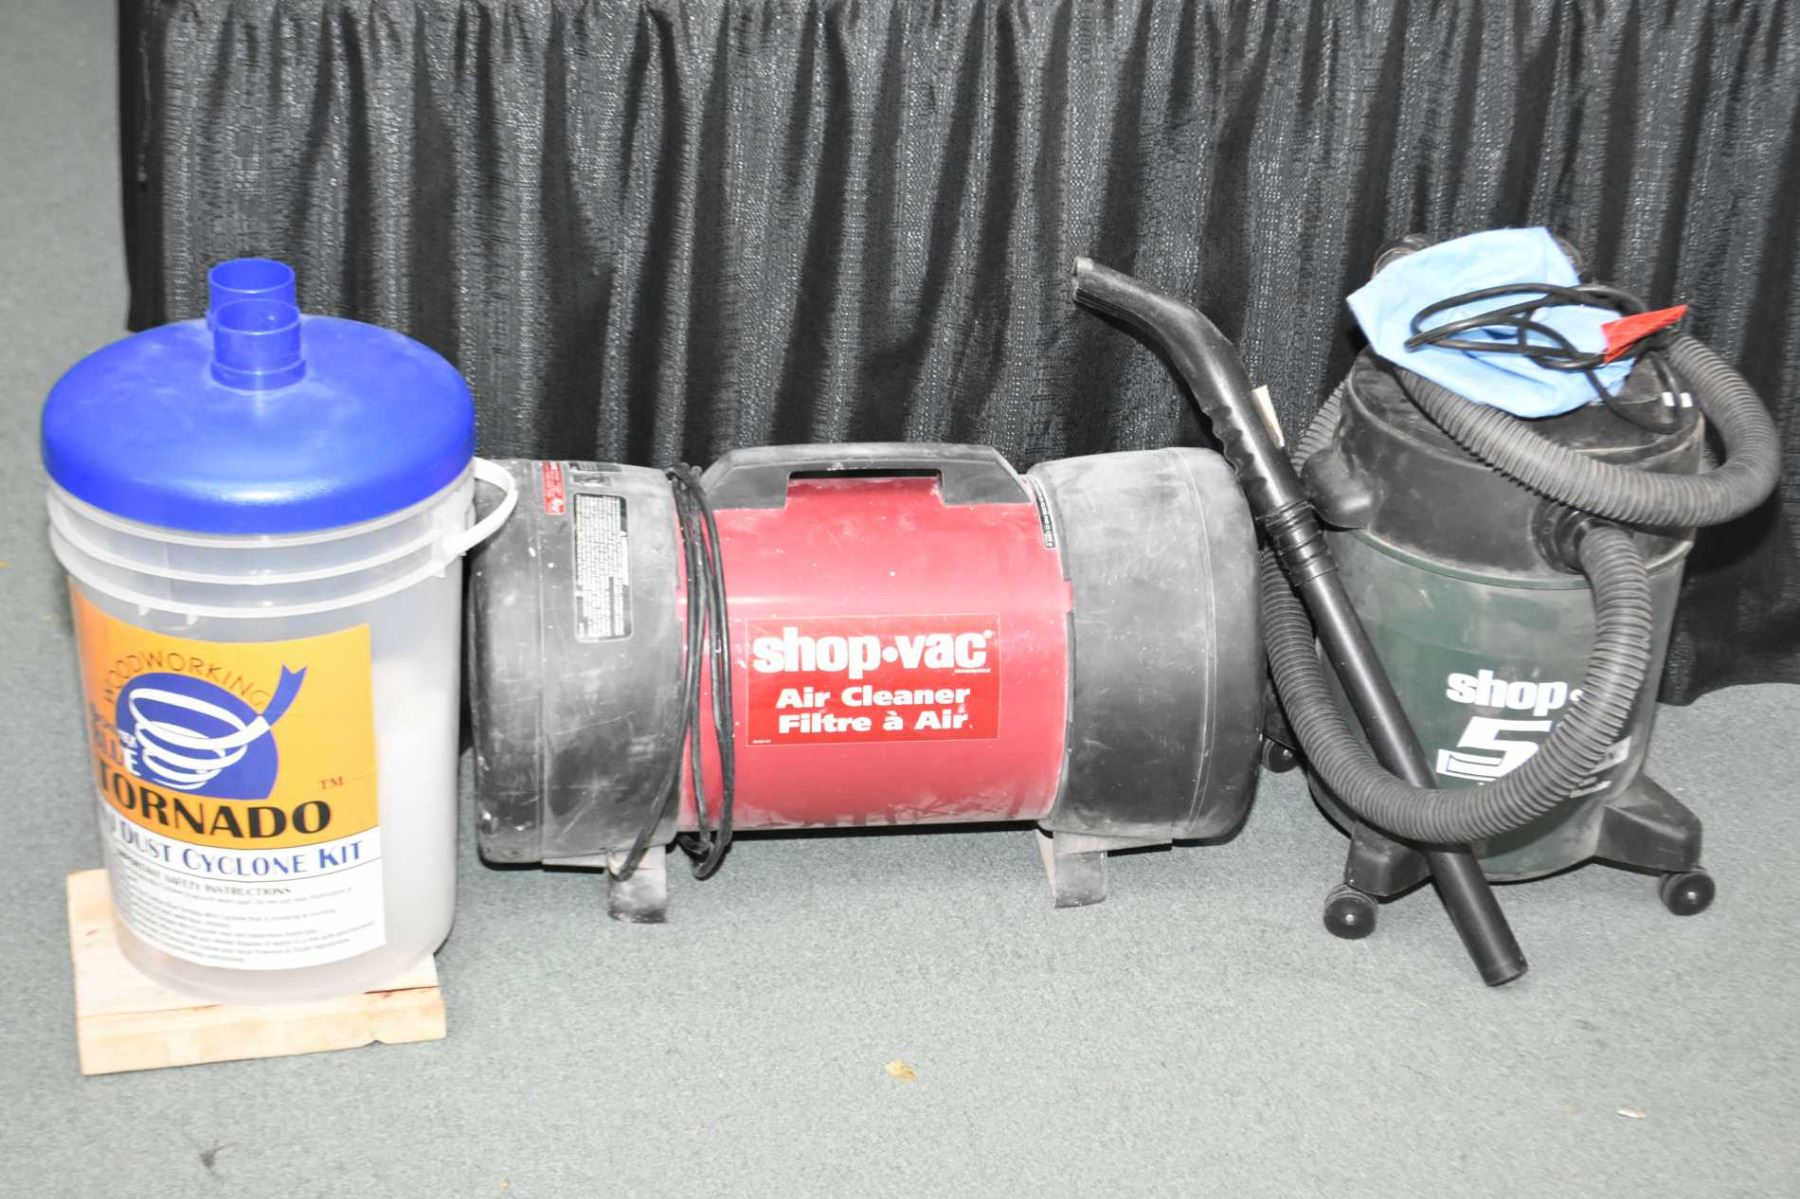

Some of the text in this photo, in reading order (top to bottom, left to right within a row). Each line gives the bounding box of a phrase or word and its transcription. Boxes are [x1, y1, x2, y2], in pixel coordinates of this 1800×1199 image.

[775, 685, 971, 710] Air Cleaner
[778, 709, 969, 734] Filtre à Air
[318, 775, 345, 791] TM
[97, 763, 333, 839] TORNADO
[120, 820, 172, 863] DUST
[183, 847, 308, 877] CYCLONE
[318, 840, 364, 870] KIT
